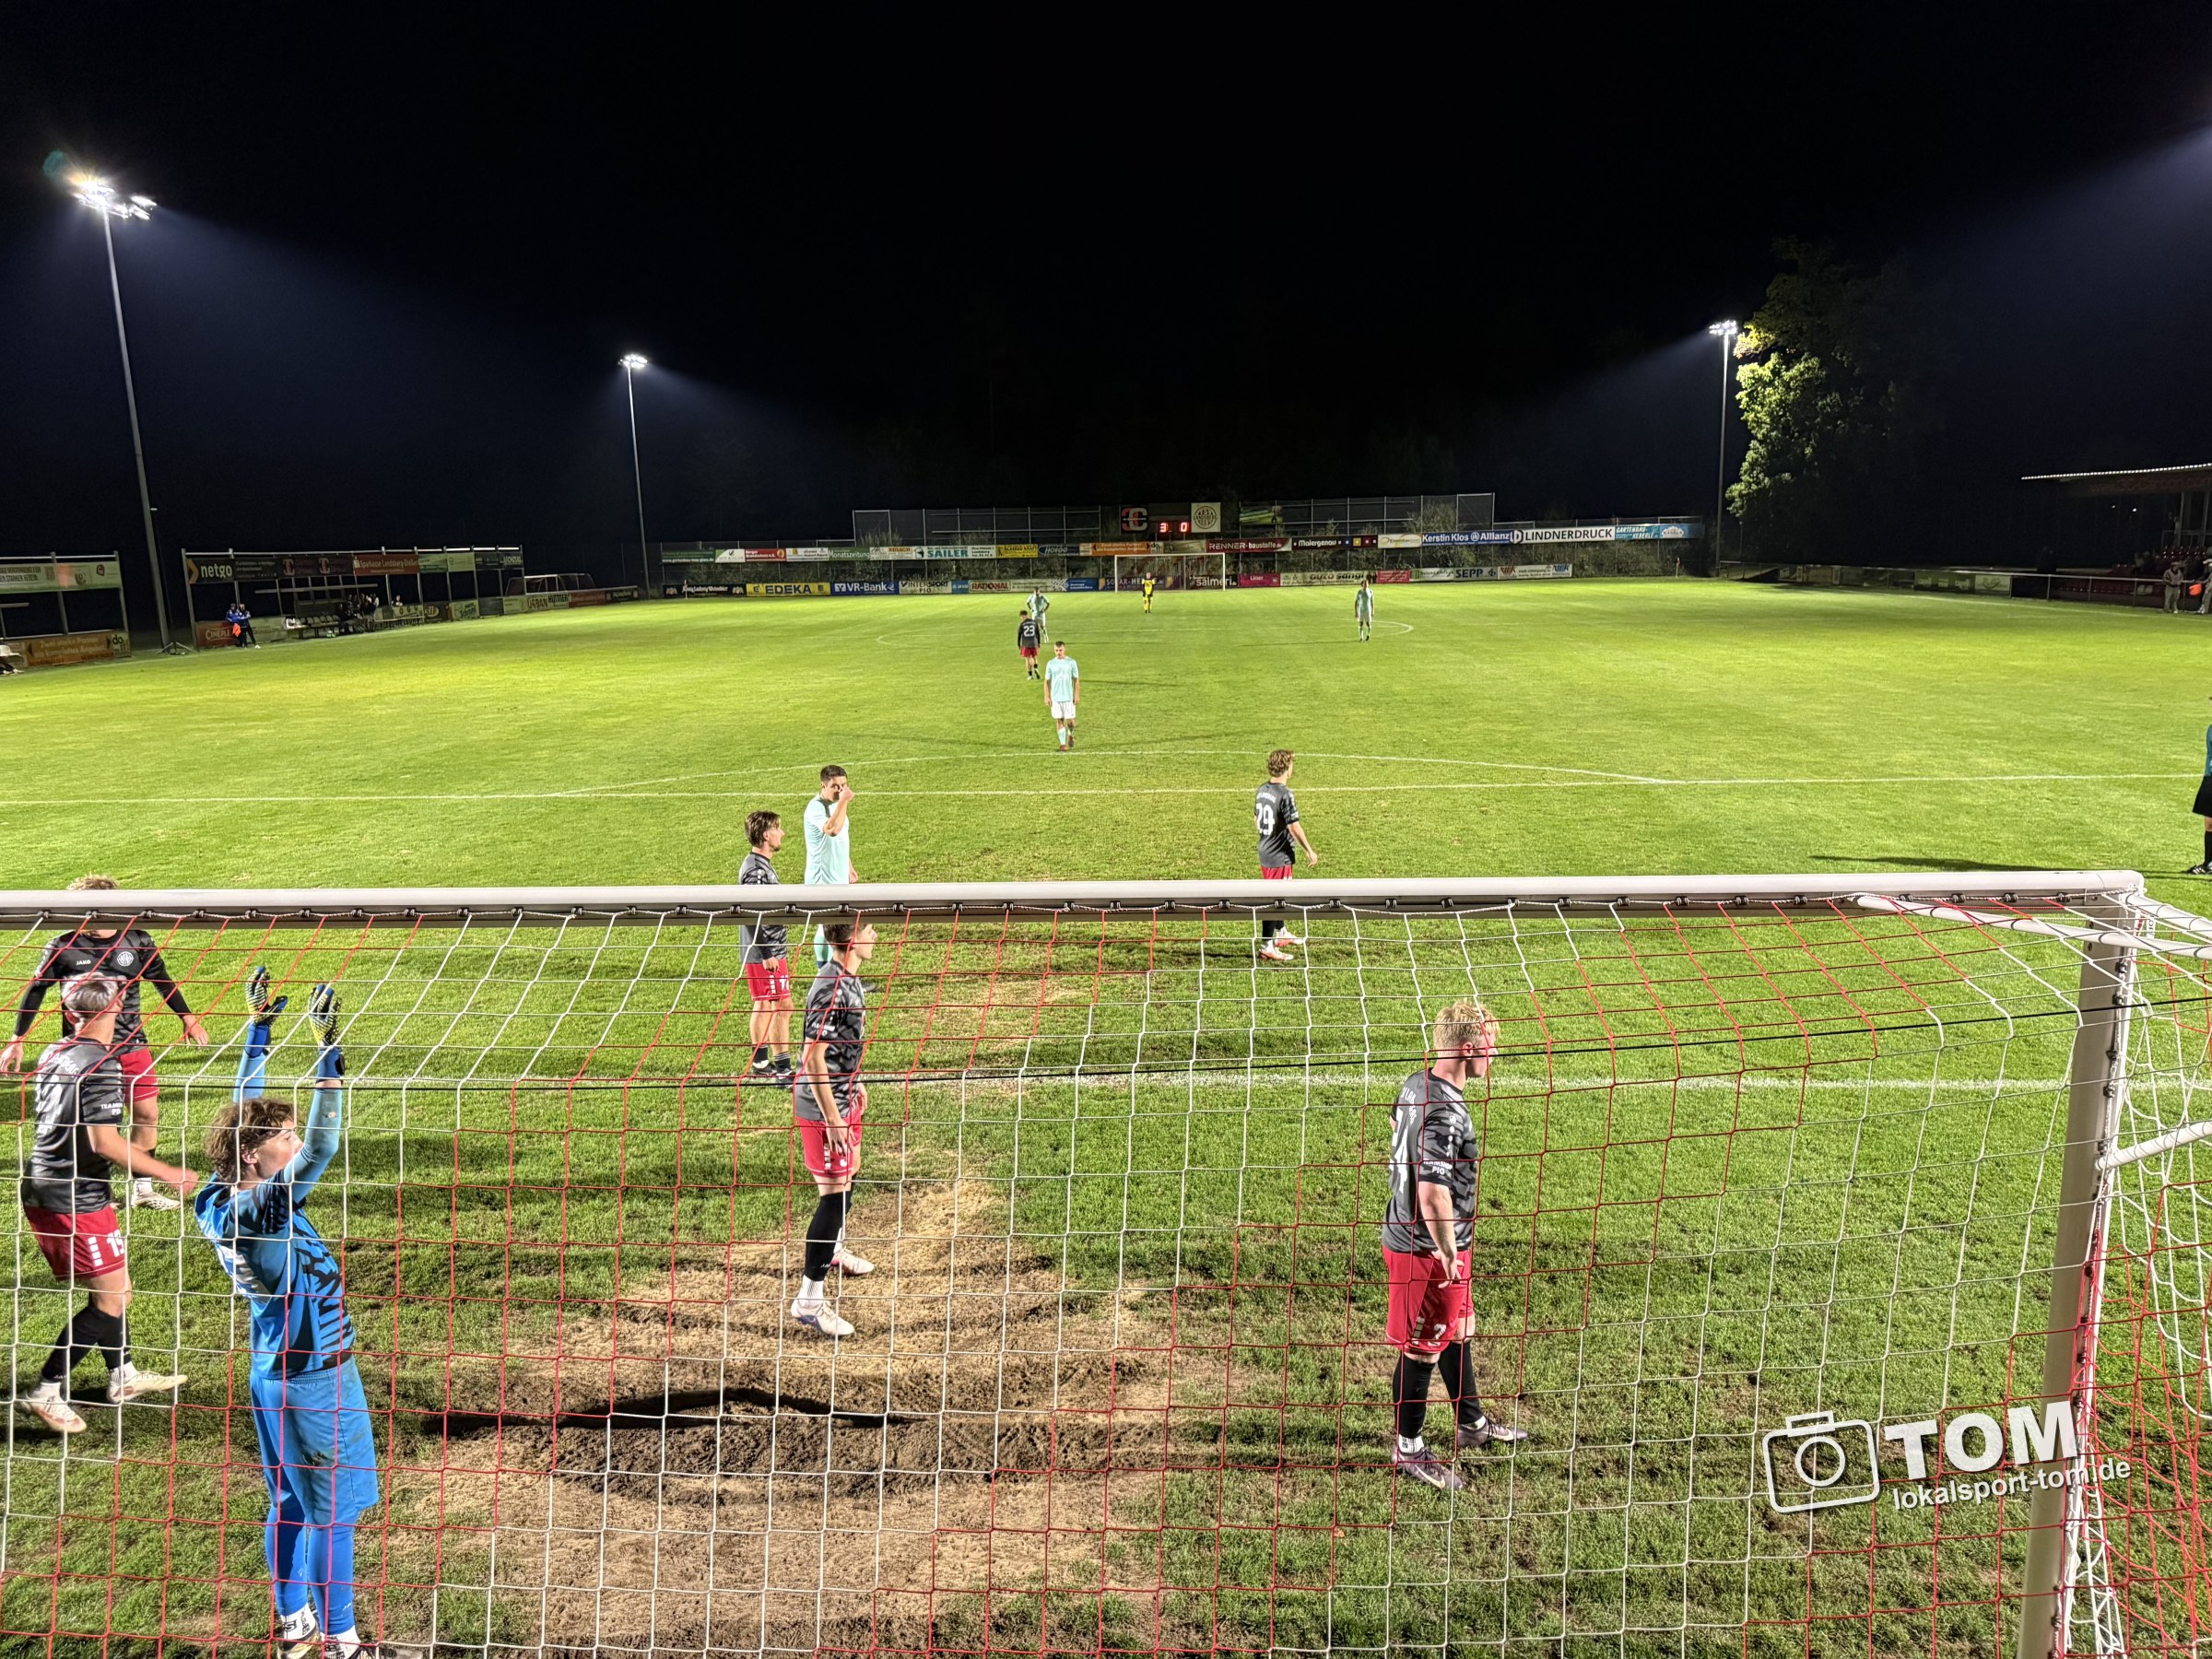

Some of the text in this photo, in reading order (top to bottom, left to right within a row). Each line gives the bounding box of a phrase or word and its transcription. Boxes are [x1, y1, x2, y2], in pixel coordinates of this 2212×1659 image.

[1159, 523, 1168, 533] 3
[1180, 522, 1189, 533] 0
[1422, 534, 1450, 542] Kerstin
[1451, 533, 1469, 542] Klos
[1479, 532, 1510, 541] Allianz
[1524, 528, 1613, 541] LINDNERDRUCK
[829, 550, 870, 559] Monatszeitung
[927, 549, 969, 558] SAILER
[359, 559, 382, 569] Sparkasse
[200, 562, 233, 579] netgo
[1455, 568, 1484, 578] SEPP
[765, 584, 811, 594] EDEKA
[846, 582, 887, 592] VR-Bank
[971, 582, 1009, 590] RATIONAL
[205, 628, 230, 641] CINEPLE
[1023, 625, 1035, 637] 23
[1431, 1166, 1445, 1176] PIO
